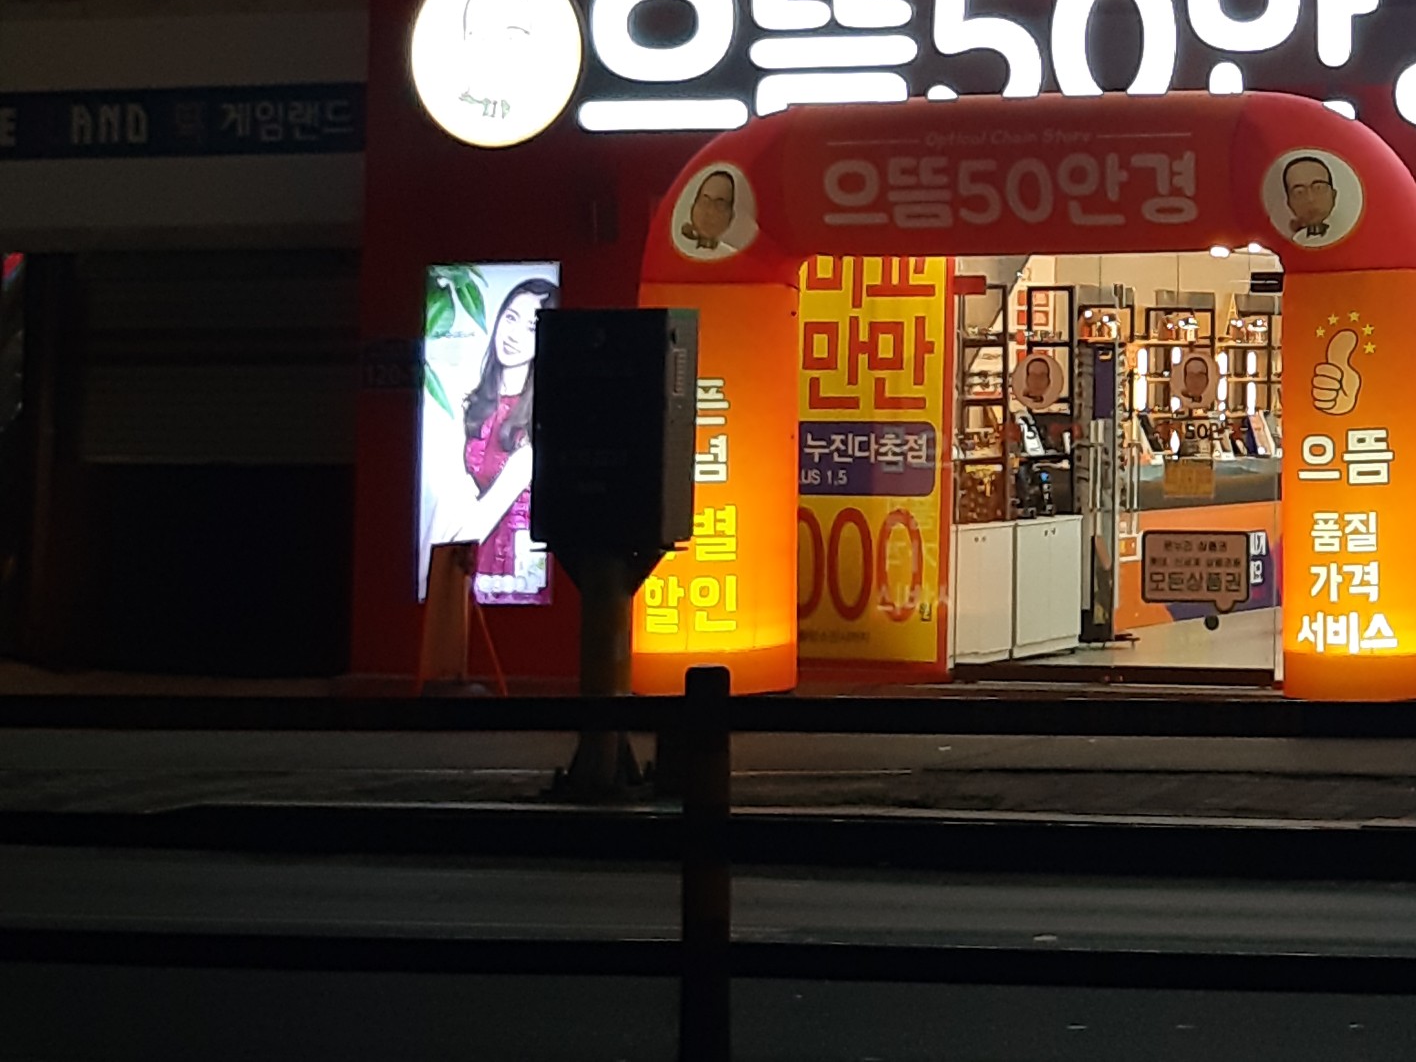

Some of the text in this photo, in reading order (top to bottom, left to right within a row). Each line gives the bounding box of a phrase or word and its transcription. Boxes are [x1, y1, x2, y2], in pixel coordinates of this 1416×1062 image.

[218, 100, 356, 144] 게임랜드
[823, 150, 1199, 229] 으뜸50안경
[804, 315, 936, 411] 만만
[696, 379, 730, 426] 픈
[694, 434, 728, 482] 념
[803, 432, 928, 465] 누진다초점
[1297, 427, 1396, 487] 으뜸
[693, 504, 738, 562] 별
[1309, 510, 1379, 555] 품질
[644, 574, 739, 635] 할인
[1149, 571, 1241, 593] 모든상품권
[1308, 562, 1381, 603] 가격
[1296, 610, 1399, 655] 서비스
